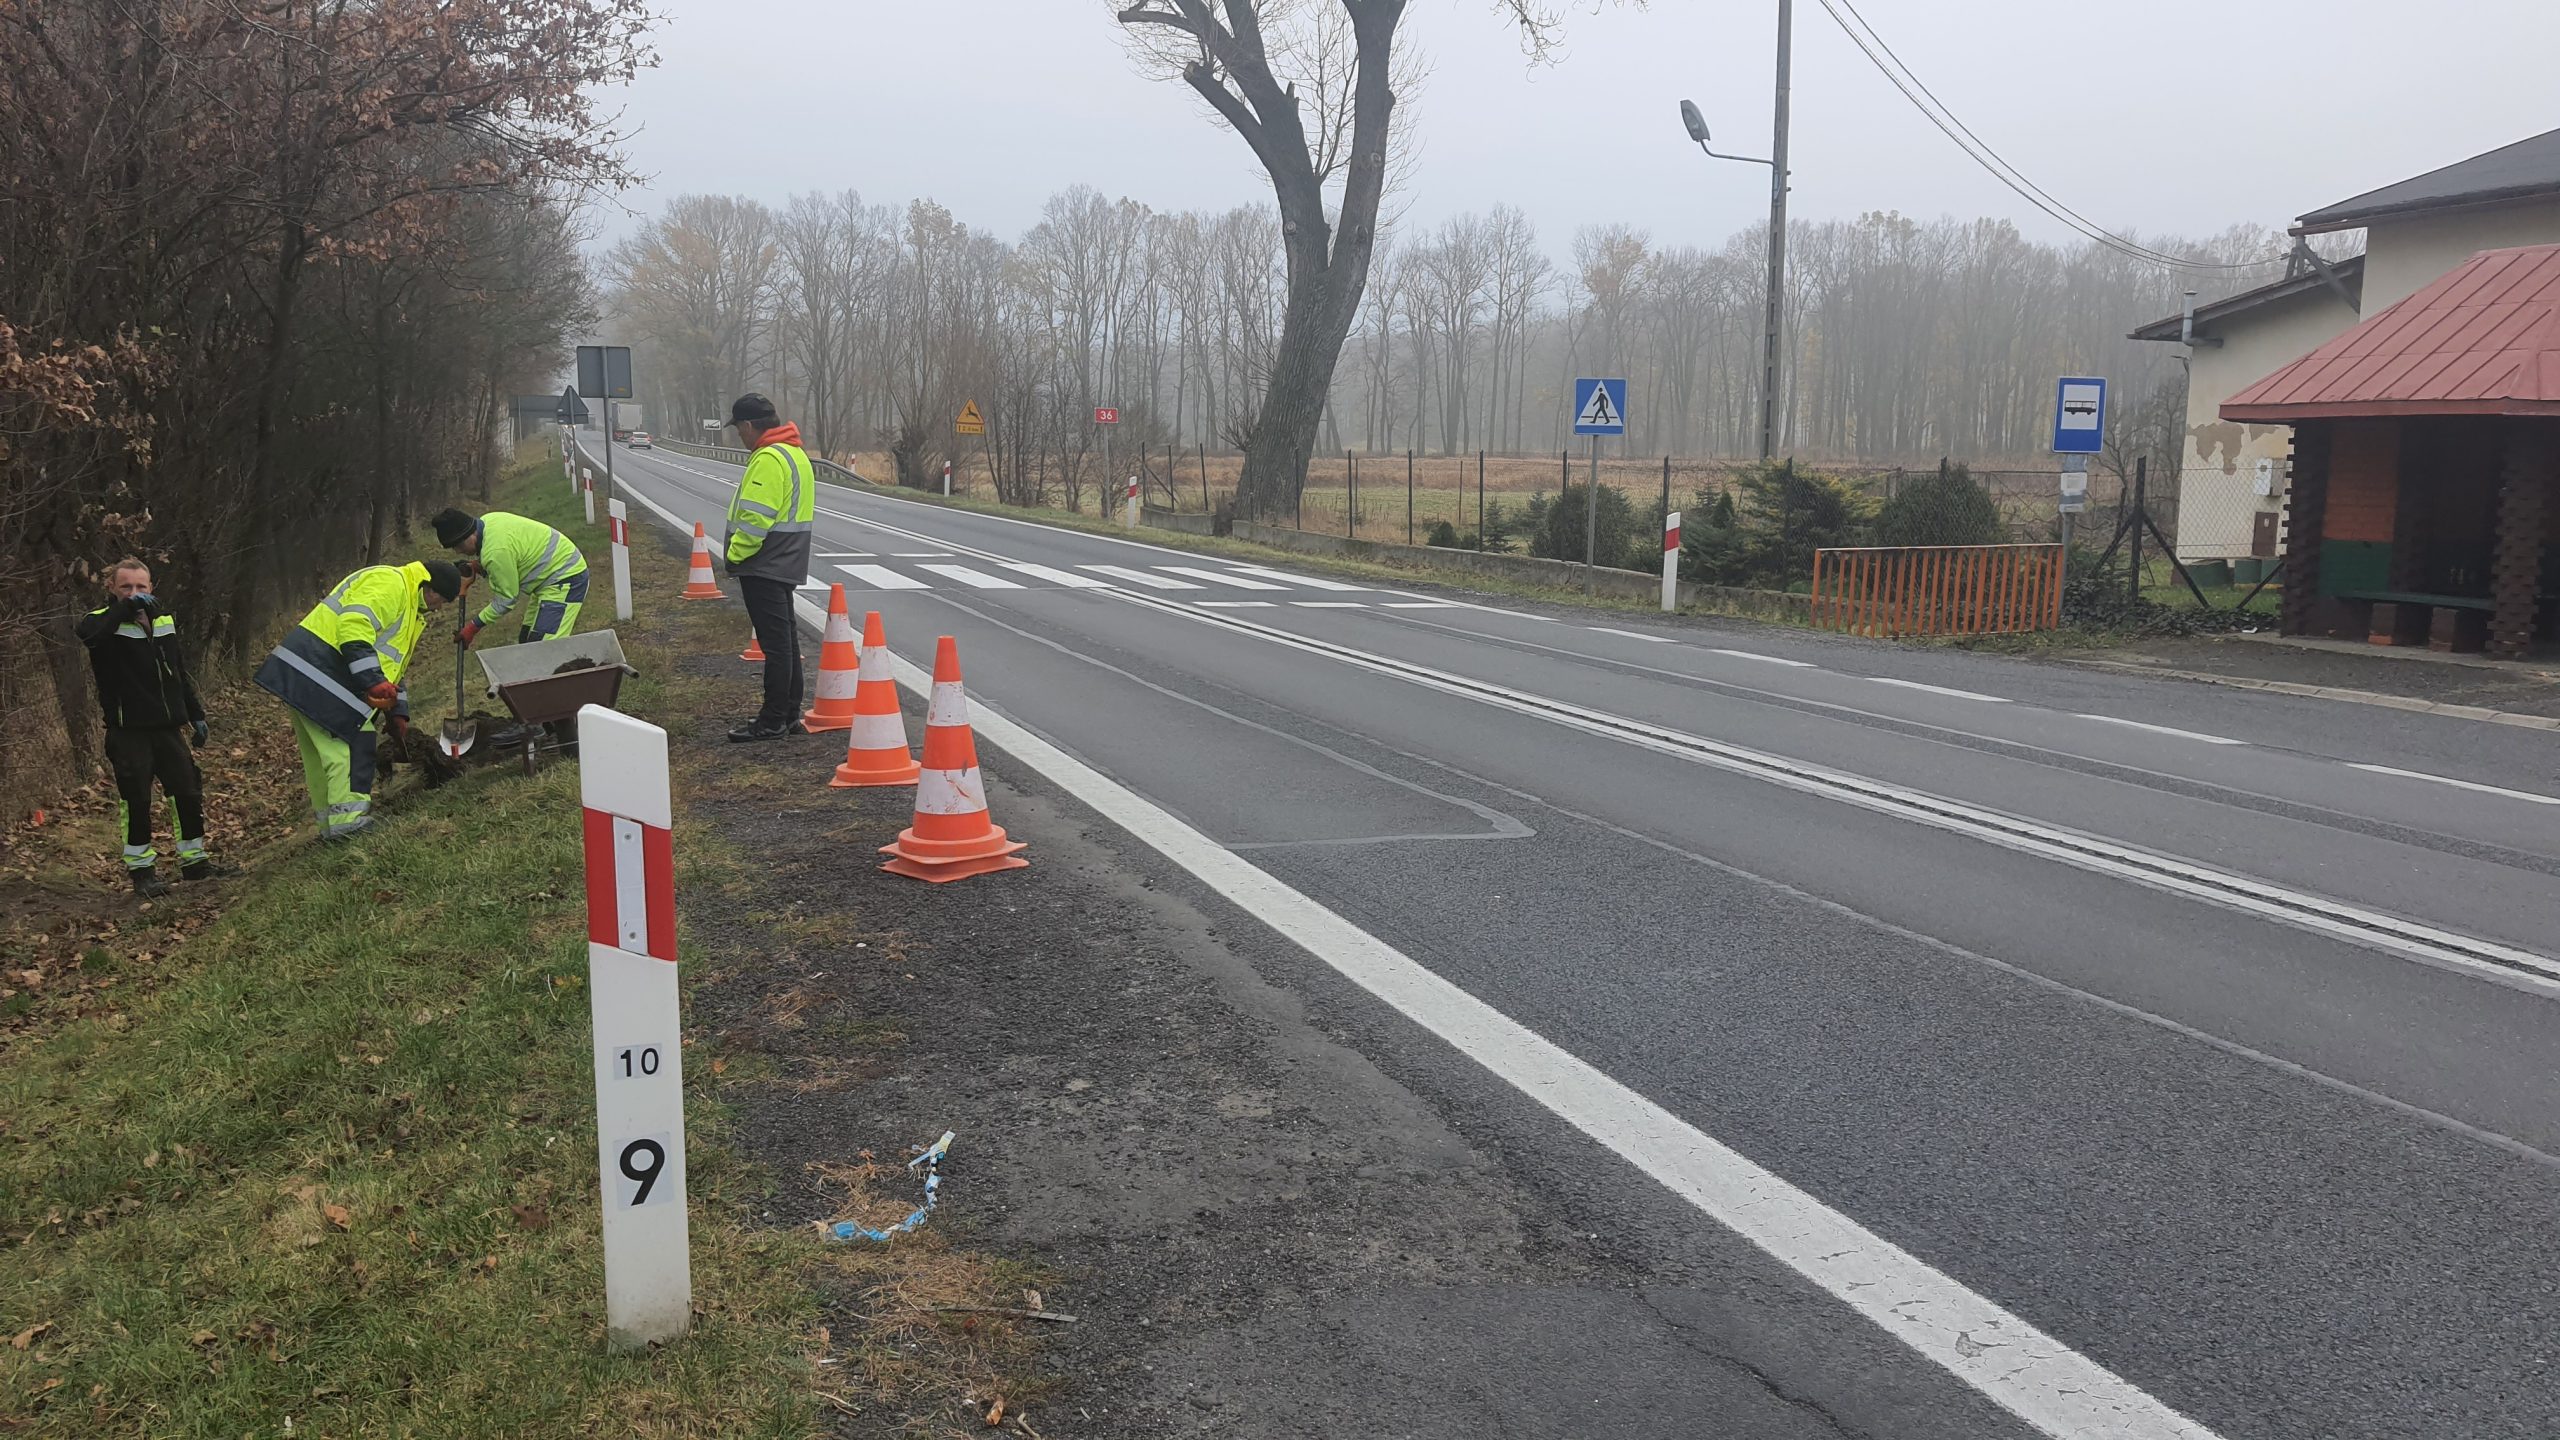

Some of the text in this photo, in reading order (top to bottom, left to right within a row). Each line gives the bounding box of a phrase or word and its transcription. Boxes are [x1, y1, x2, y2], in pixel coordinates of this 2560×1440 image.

[1100, 410, 1112, 420] 36
[620, 1048, 659, 1077] 10
[619, 1138, 665, 1206] 9
